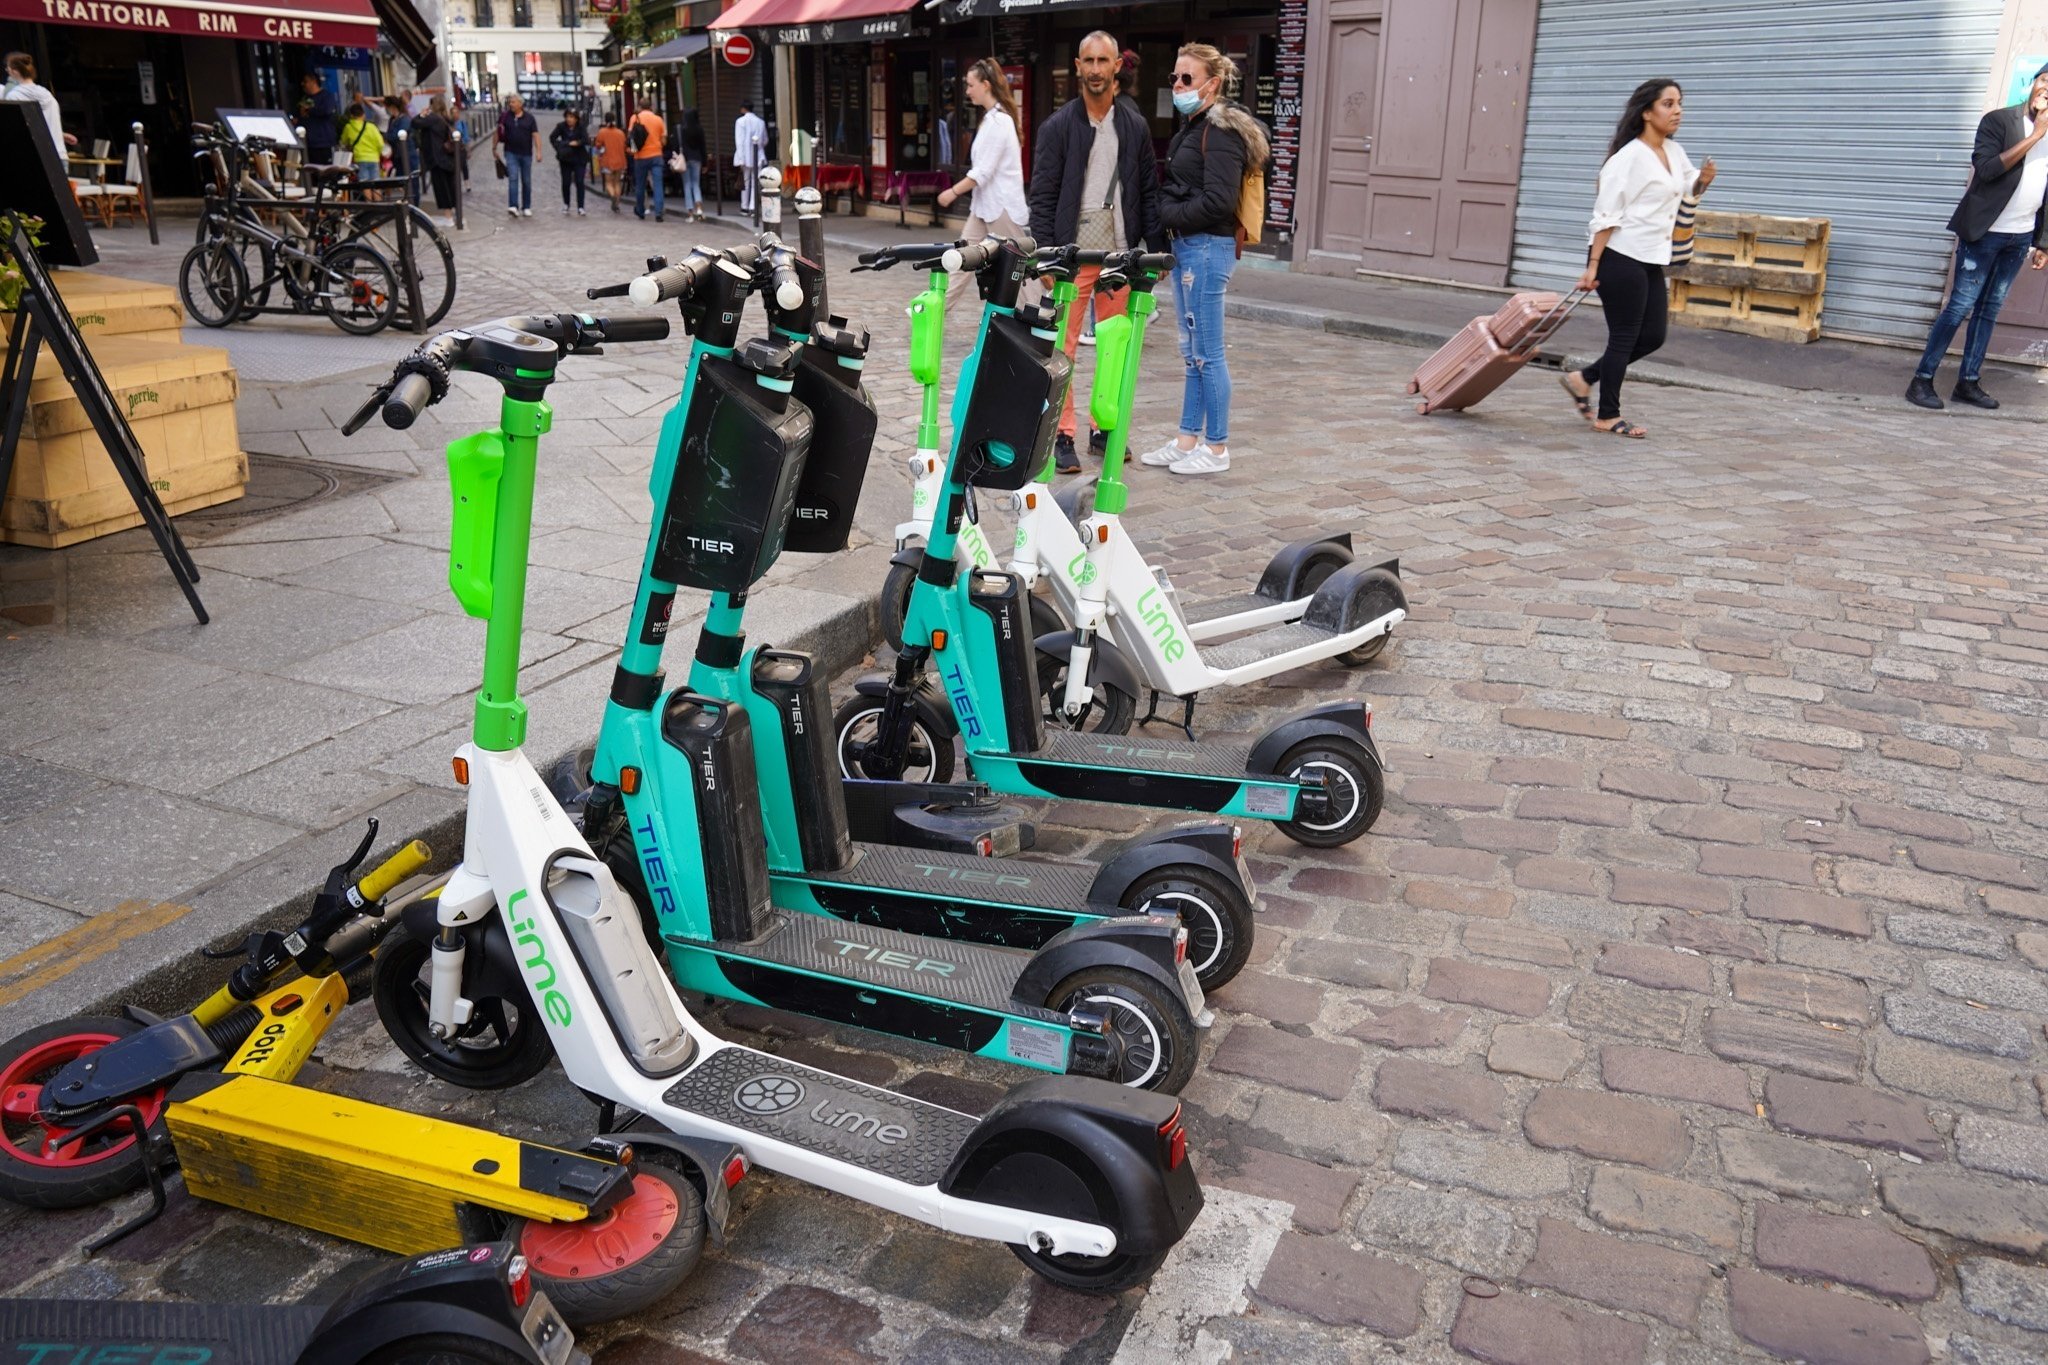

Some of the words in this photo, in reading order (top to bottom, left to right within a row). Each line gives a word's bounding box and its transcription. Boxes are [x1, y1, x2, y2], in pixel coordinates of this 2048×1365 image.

[42, 0, 170, 27] TRATTORIA
[198, 13, 238, 33] RIM
[264, 18, 313, 39] CAFE
[76, 313, 105, 330] perrier
[128, 387, 159, 416] perrier
[151, 477, 170, 491] rrier
[796, 508, 828, 519] IER
[686, 536, 734, 555] TIER
[961, 522, 988, 567] ime
[1001, 605, 1011, 640] TIER
[1137, 586, 1184, 664] Lime
[791, 693, 803, 735] TIER
[947, 664, 981, 738] TIER
[702, 746, 716, 791] TIER
[1096, 744, 1195, 761] TIER
[637, 814, 676, 916] TIER
[915, 864, 1031, 888] TIER
[508, 888, 571, 1028] Lime
[833, 939, 956, 978] TIER
[240, 1023, 286, 1066] dott
[810, 1099, 908, 1145] Lime
